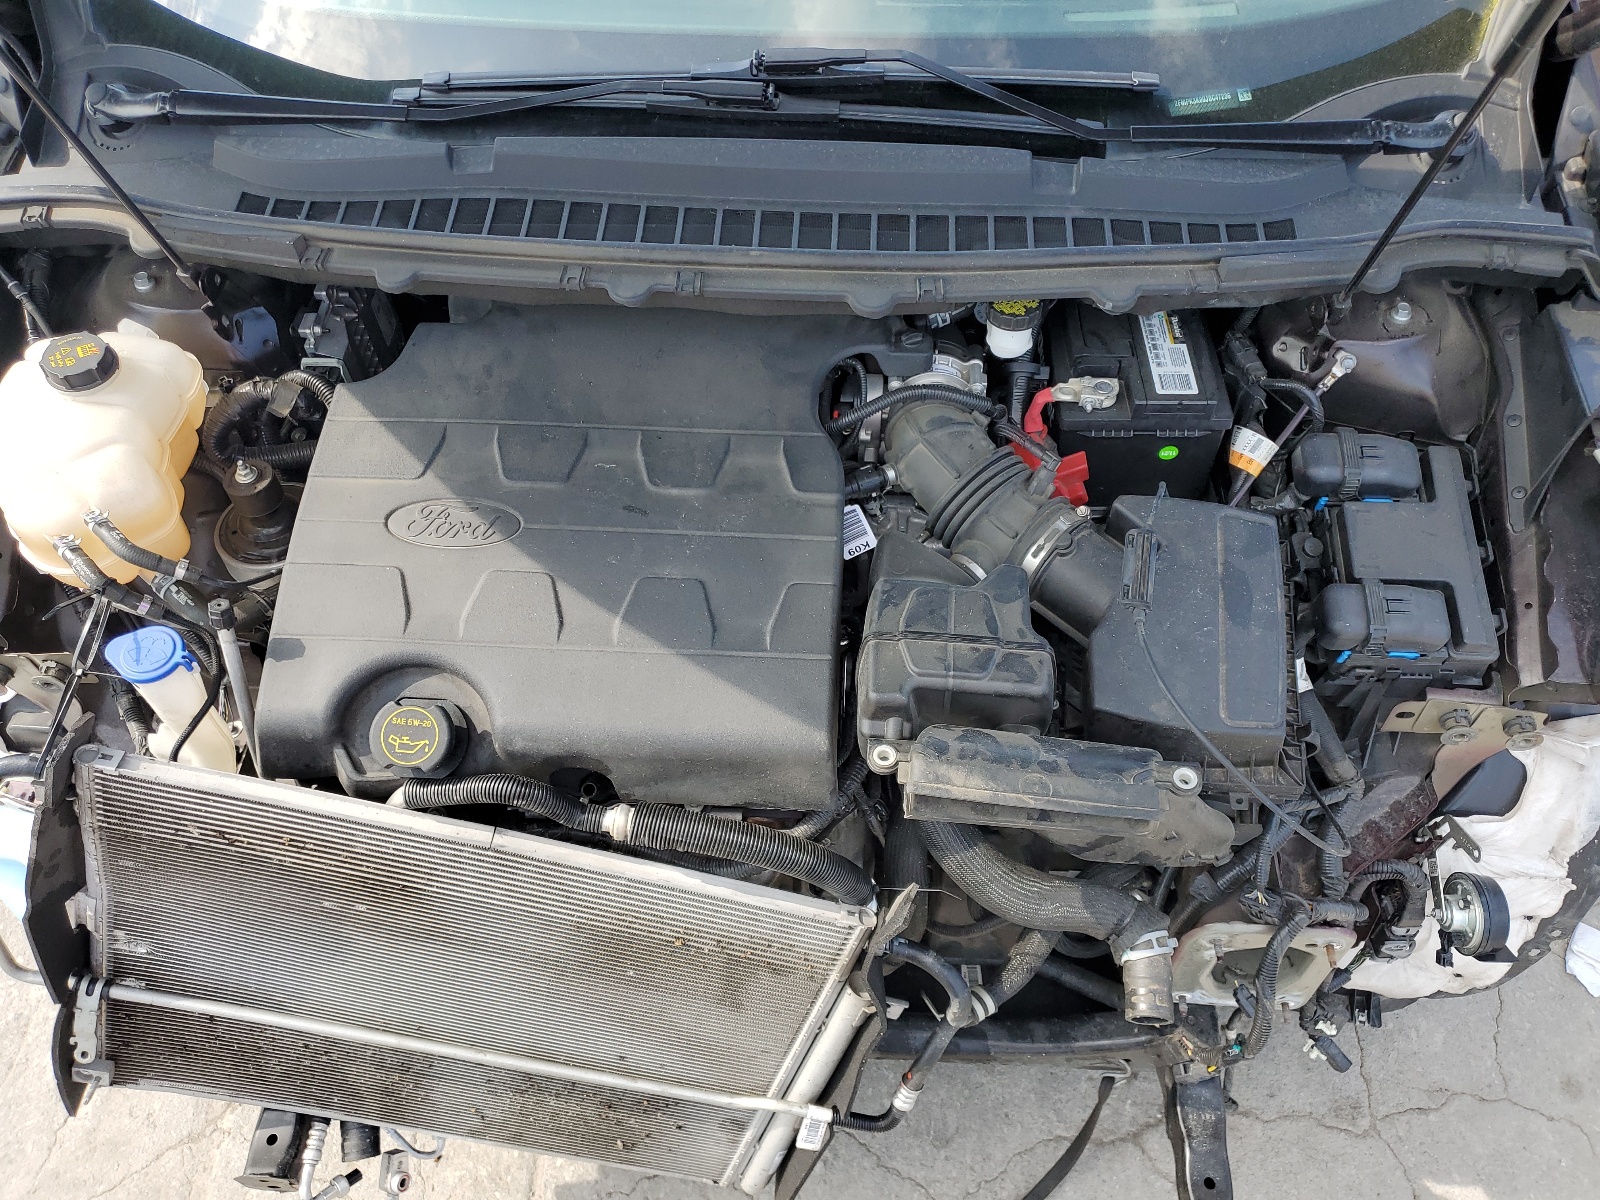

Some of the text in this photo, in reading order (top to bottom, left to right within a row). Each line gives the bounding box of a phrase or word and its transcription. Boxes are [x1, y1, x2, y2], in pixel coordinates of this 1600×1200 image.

[406, 503, 502, 541] Ford
[848, 541, 870, 557] K09
[391, 717, 407, 726] SAE
